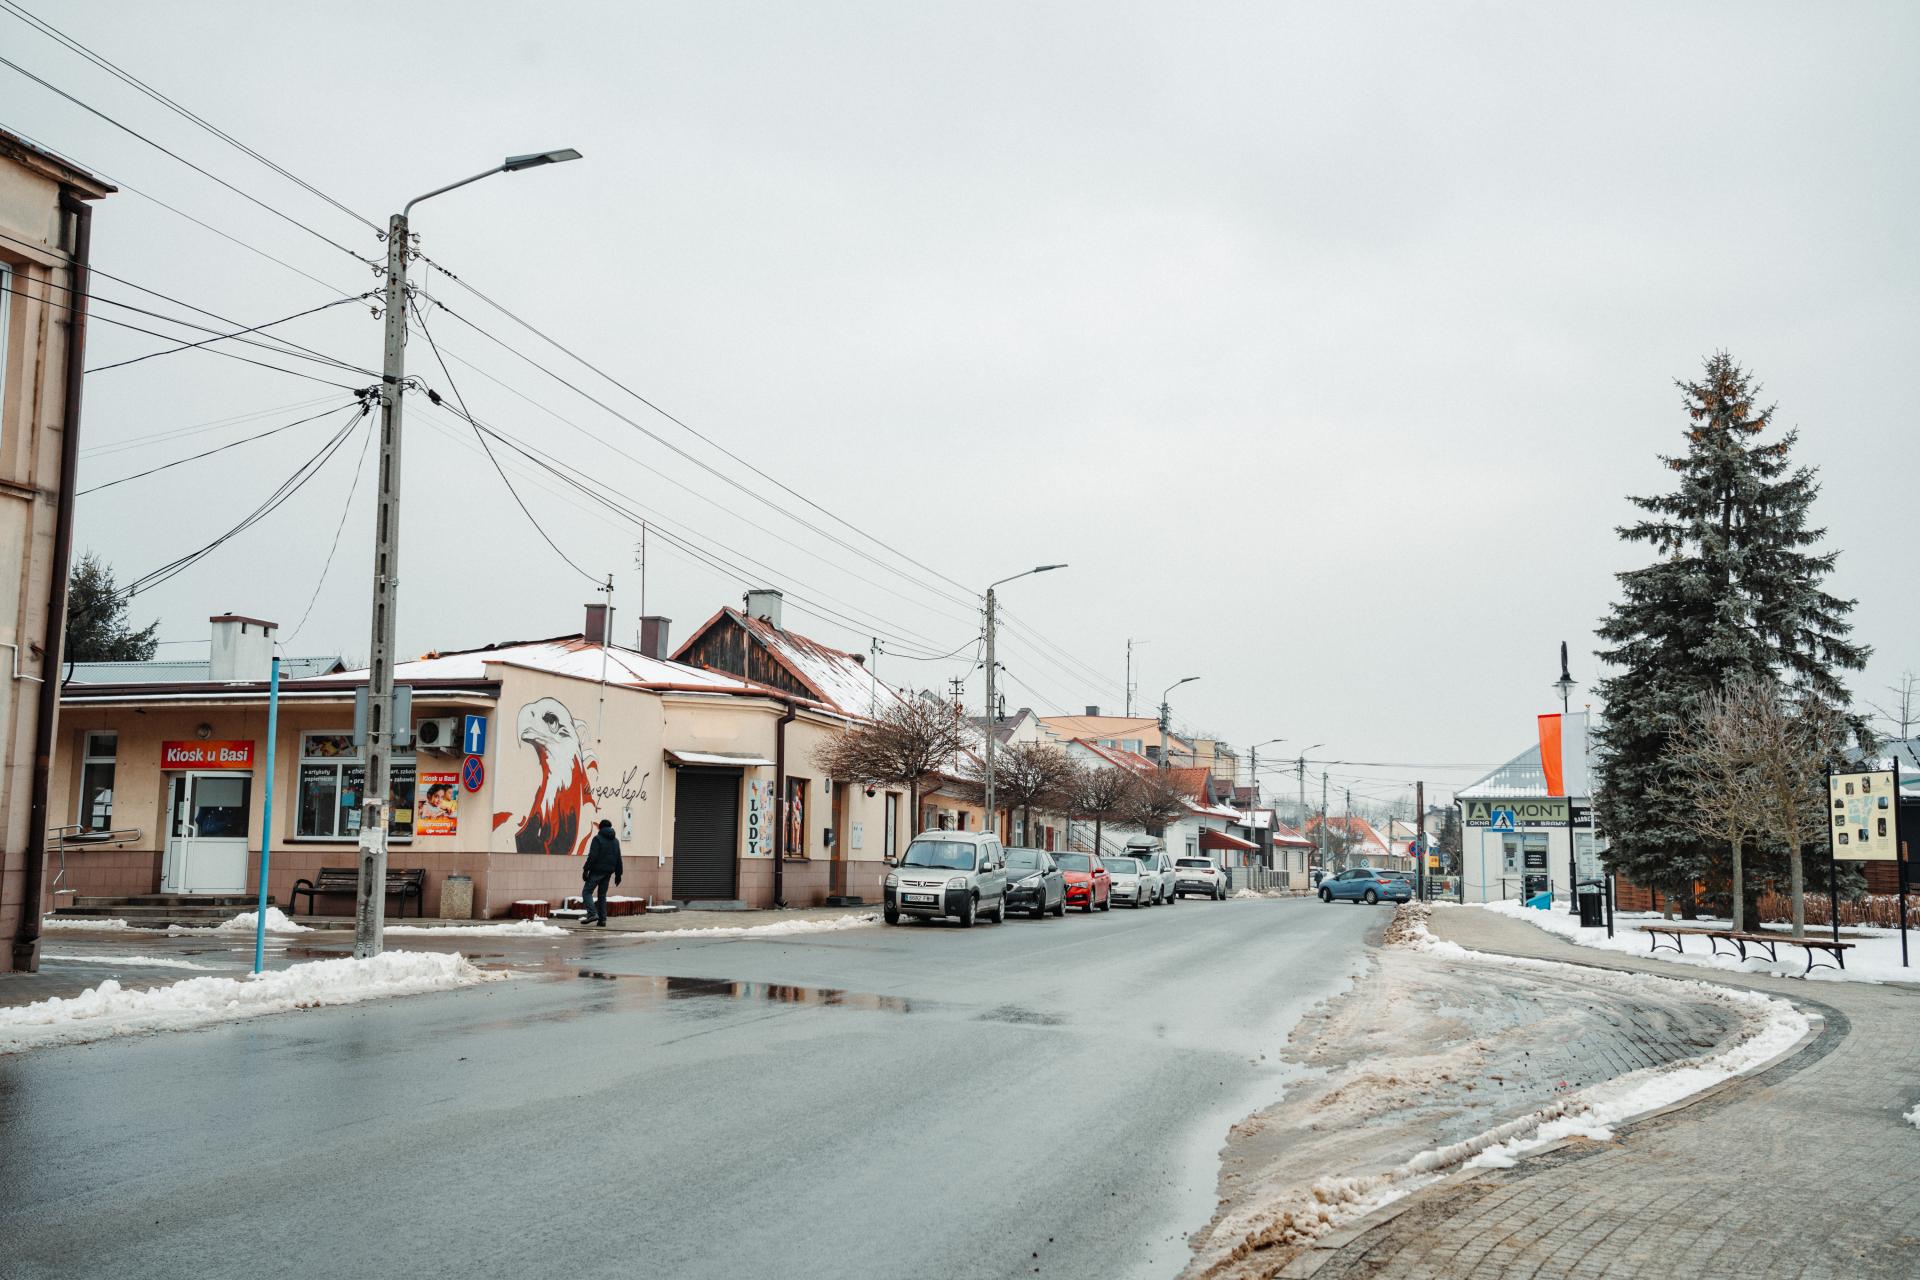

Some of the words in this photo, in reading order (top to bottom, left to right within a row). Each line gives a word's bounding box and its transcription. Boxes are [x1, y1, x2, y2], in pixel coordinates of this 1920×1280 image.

[167, 747, 204, 762] Kiosk
[207, 750, 216, 762] u
[220, 747, 249, 761] Basi
[749, 799, 759, 854] LODY
